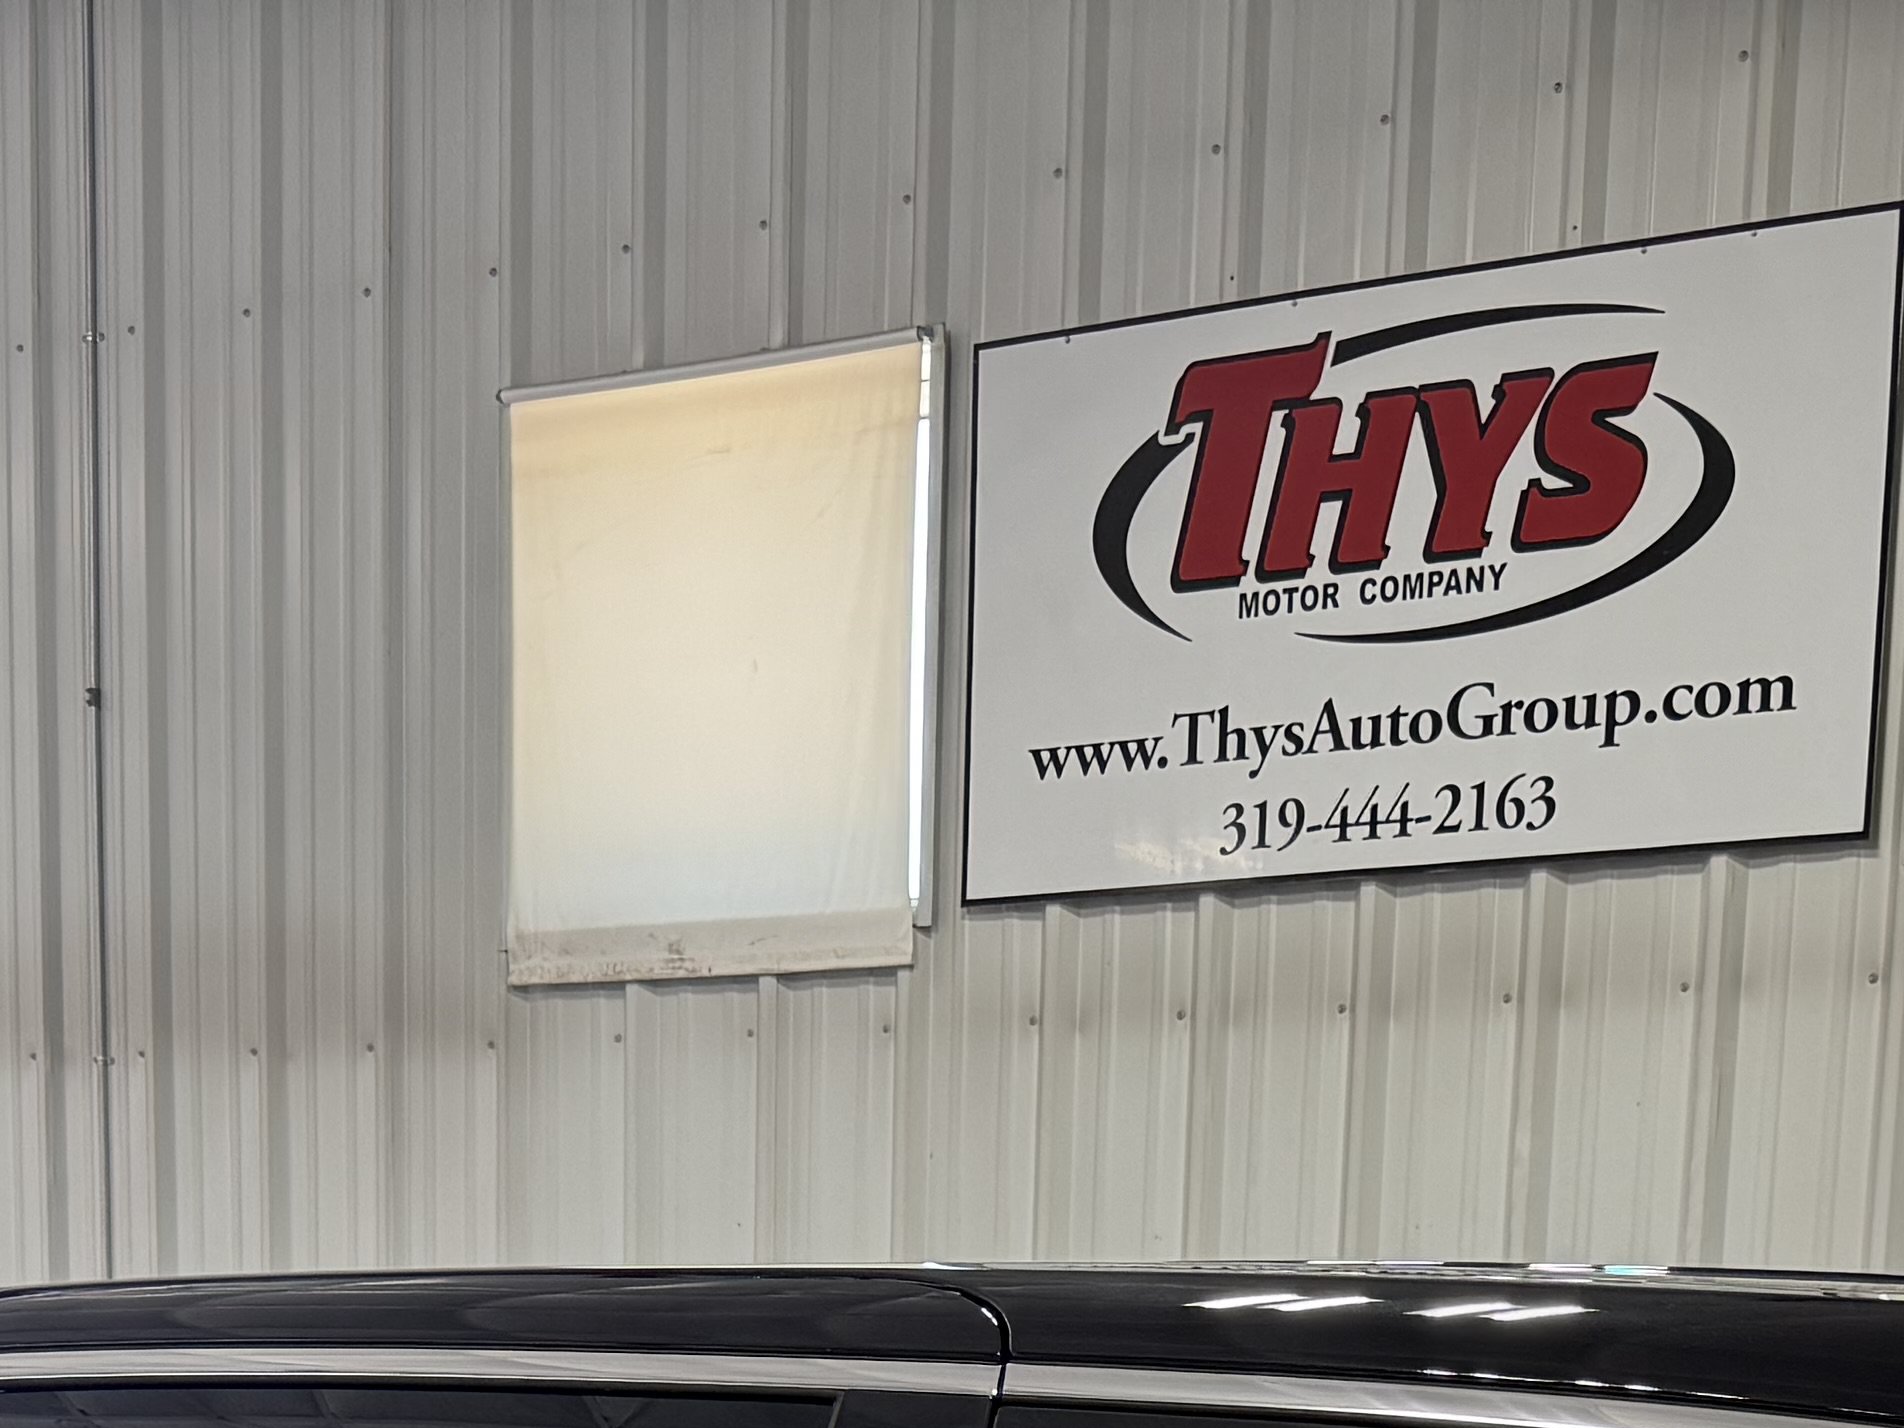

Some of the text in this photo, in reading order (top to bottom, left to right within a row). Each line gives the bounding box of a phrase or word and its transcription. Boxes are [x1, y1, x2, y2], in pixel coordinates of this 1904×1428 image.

[1158, 330, 1659, 592] THYS
[1237, 562, 1509, 620] MOTOR COMPANY
[1028, 672, 1797, 782] www.ThysAutoGroup.com
[1219, 773, 1557, 857] 319-444-2163
